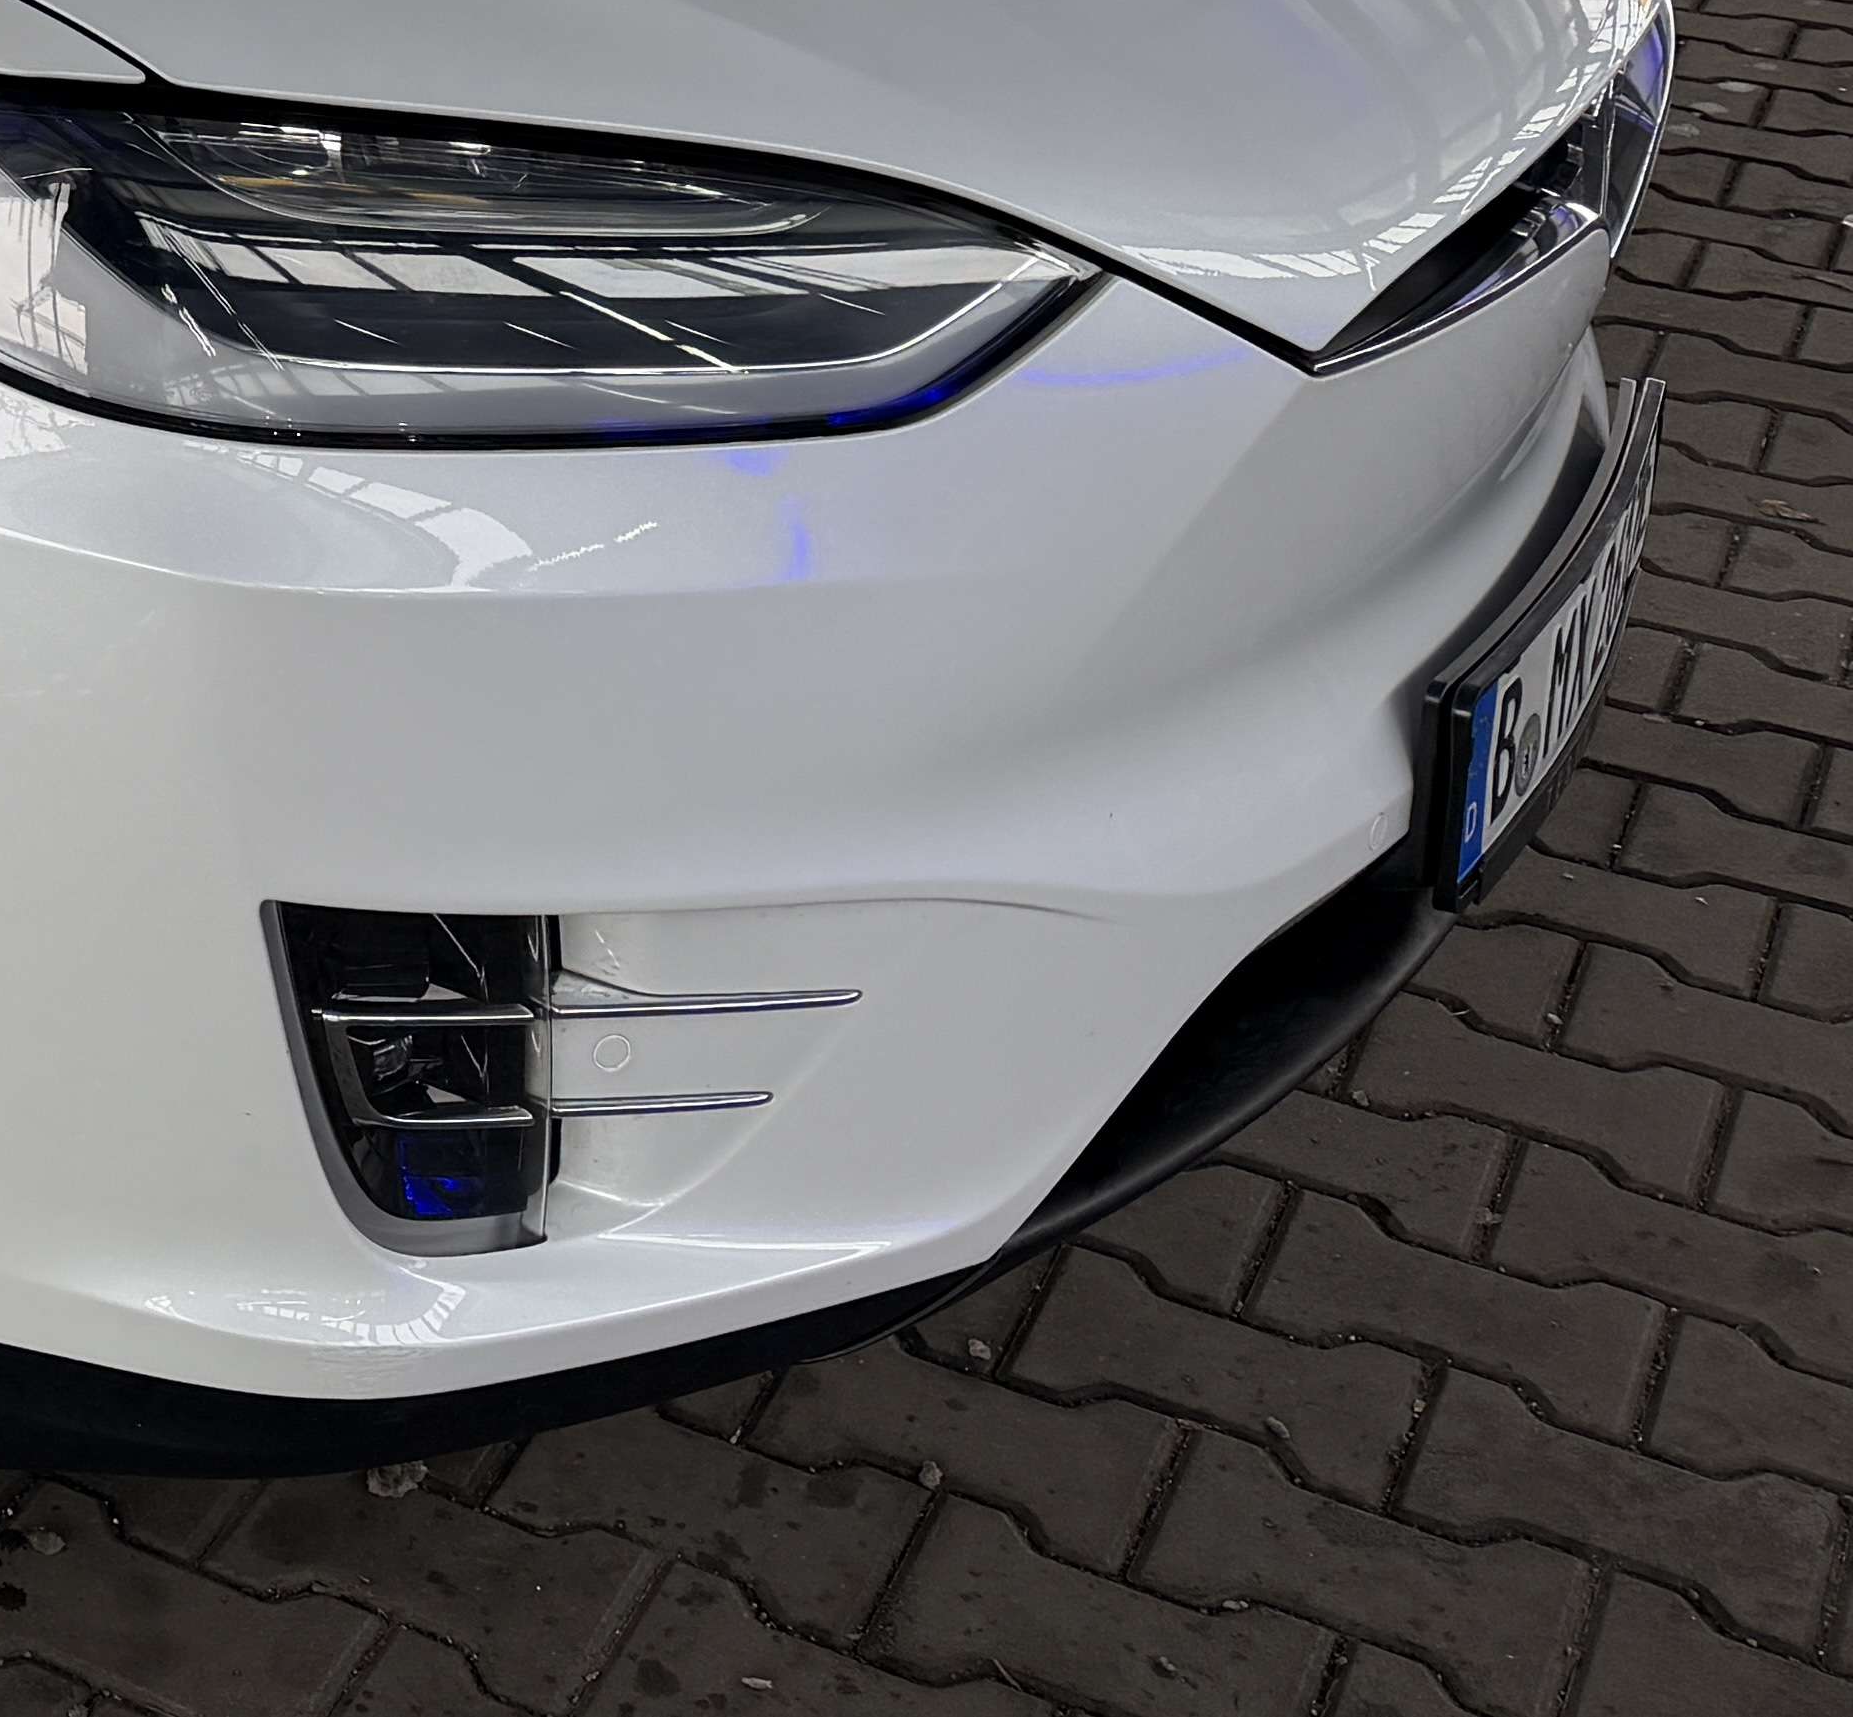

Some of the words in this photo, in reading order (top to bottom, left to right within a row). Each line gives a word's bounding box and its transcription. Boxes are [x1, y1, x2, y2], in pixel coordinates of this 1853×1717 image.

[1491, 676, 1523, 826] B
[1543, 575, 1598, 759] MX
[1464, 801, 1477, 843] D
